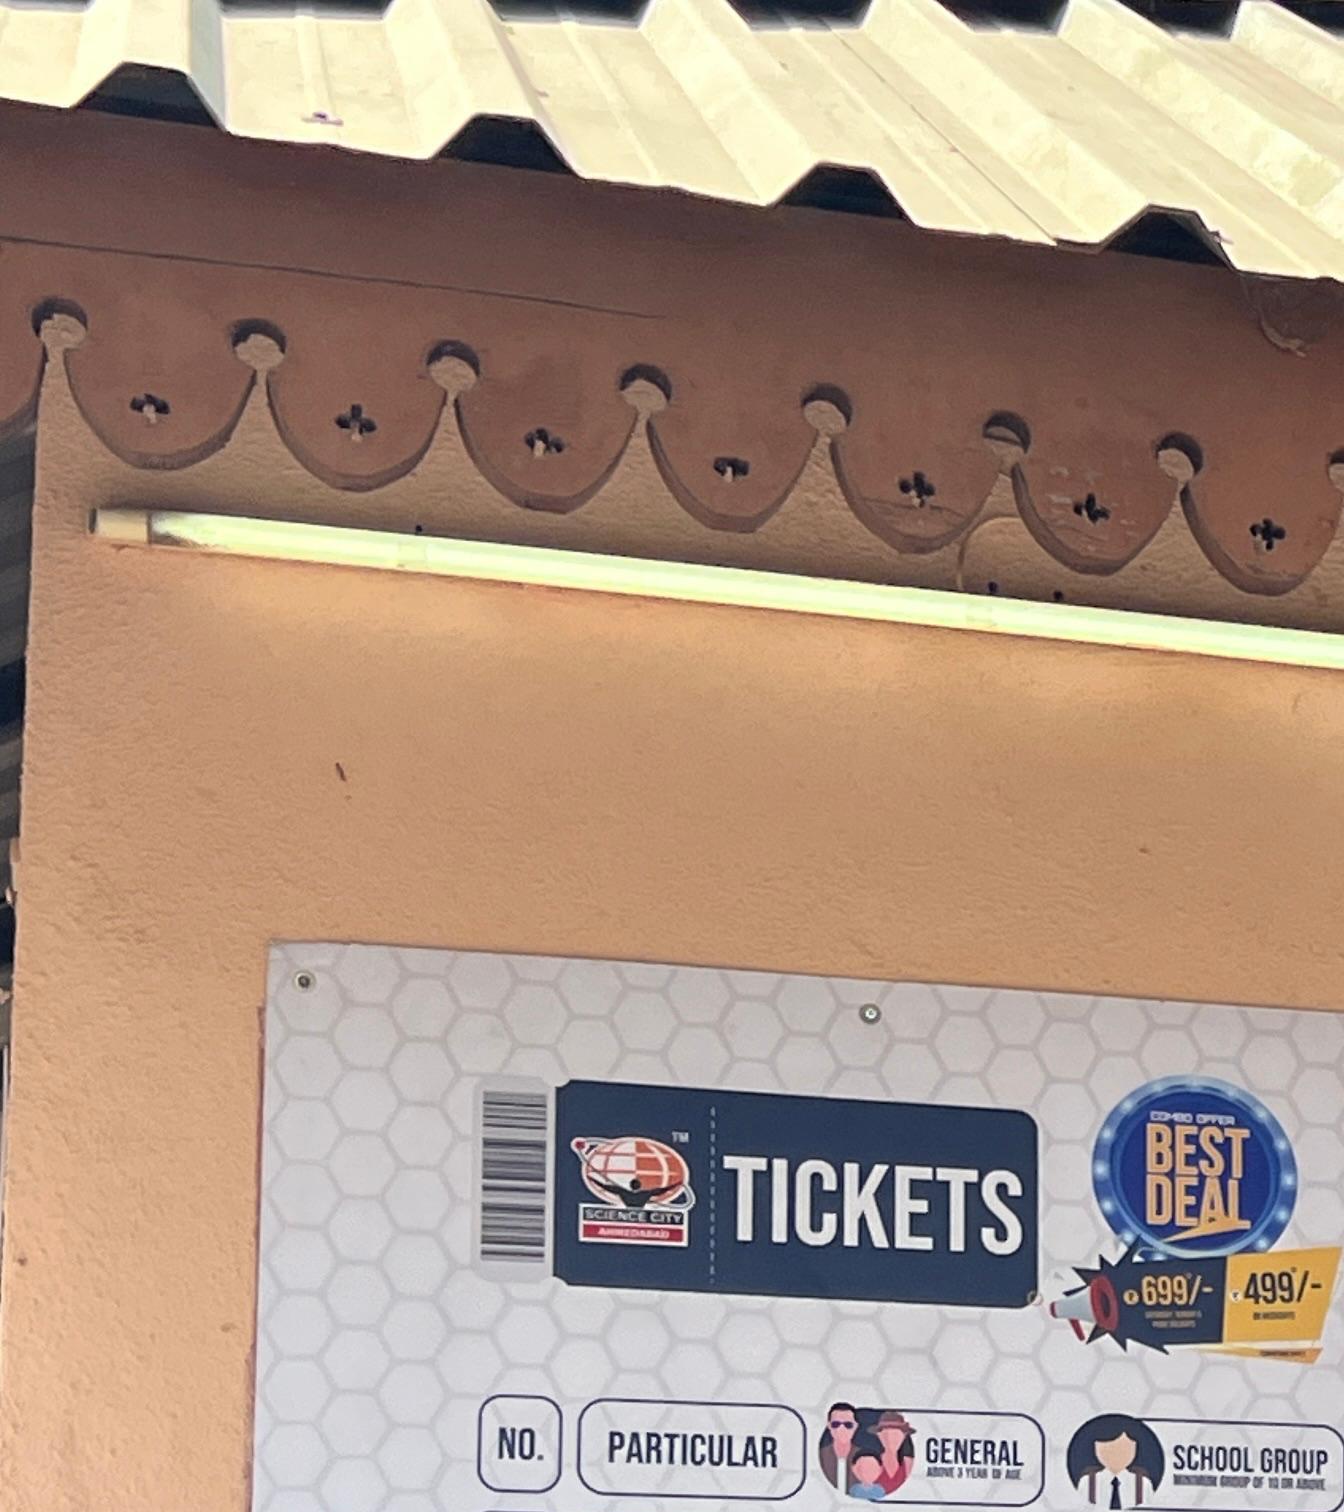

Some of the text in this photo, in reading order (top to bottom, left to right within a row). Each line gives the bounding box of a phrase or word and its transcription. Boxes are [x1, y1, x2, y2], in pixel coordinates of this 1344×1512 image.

[1146, 1122, 1250, 1179] BEST
[584, 1208, 683, 1224] SCIENCE CITY
[723, 1155, 1023, 1256] TICKETS
[1146, 1173, 1251, 1230] DEAL
[498, 1427, 545, 1461] NO.
[608, 1432, 778, 1468] PARTICULAR
[926, 1438, 1024, 1466] GENERAL
[1173, 1445, 1328, 1475] SCHOOL GROUP
[926, 1466, 954, 1478] ABOVE
[966, 1468, 988, 1478] YEAR
[1005, 1469, 1021, 1480] AGE
